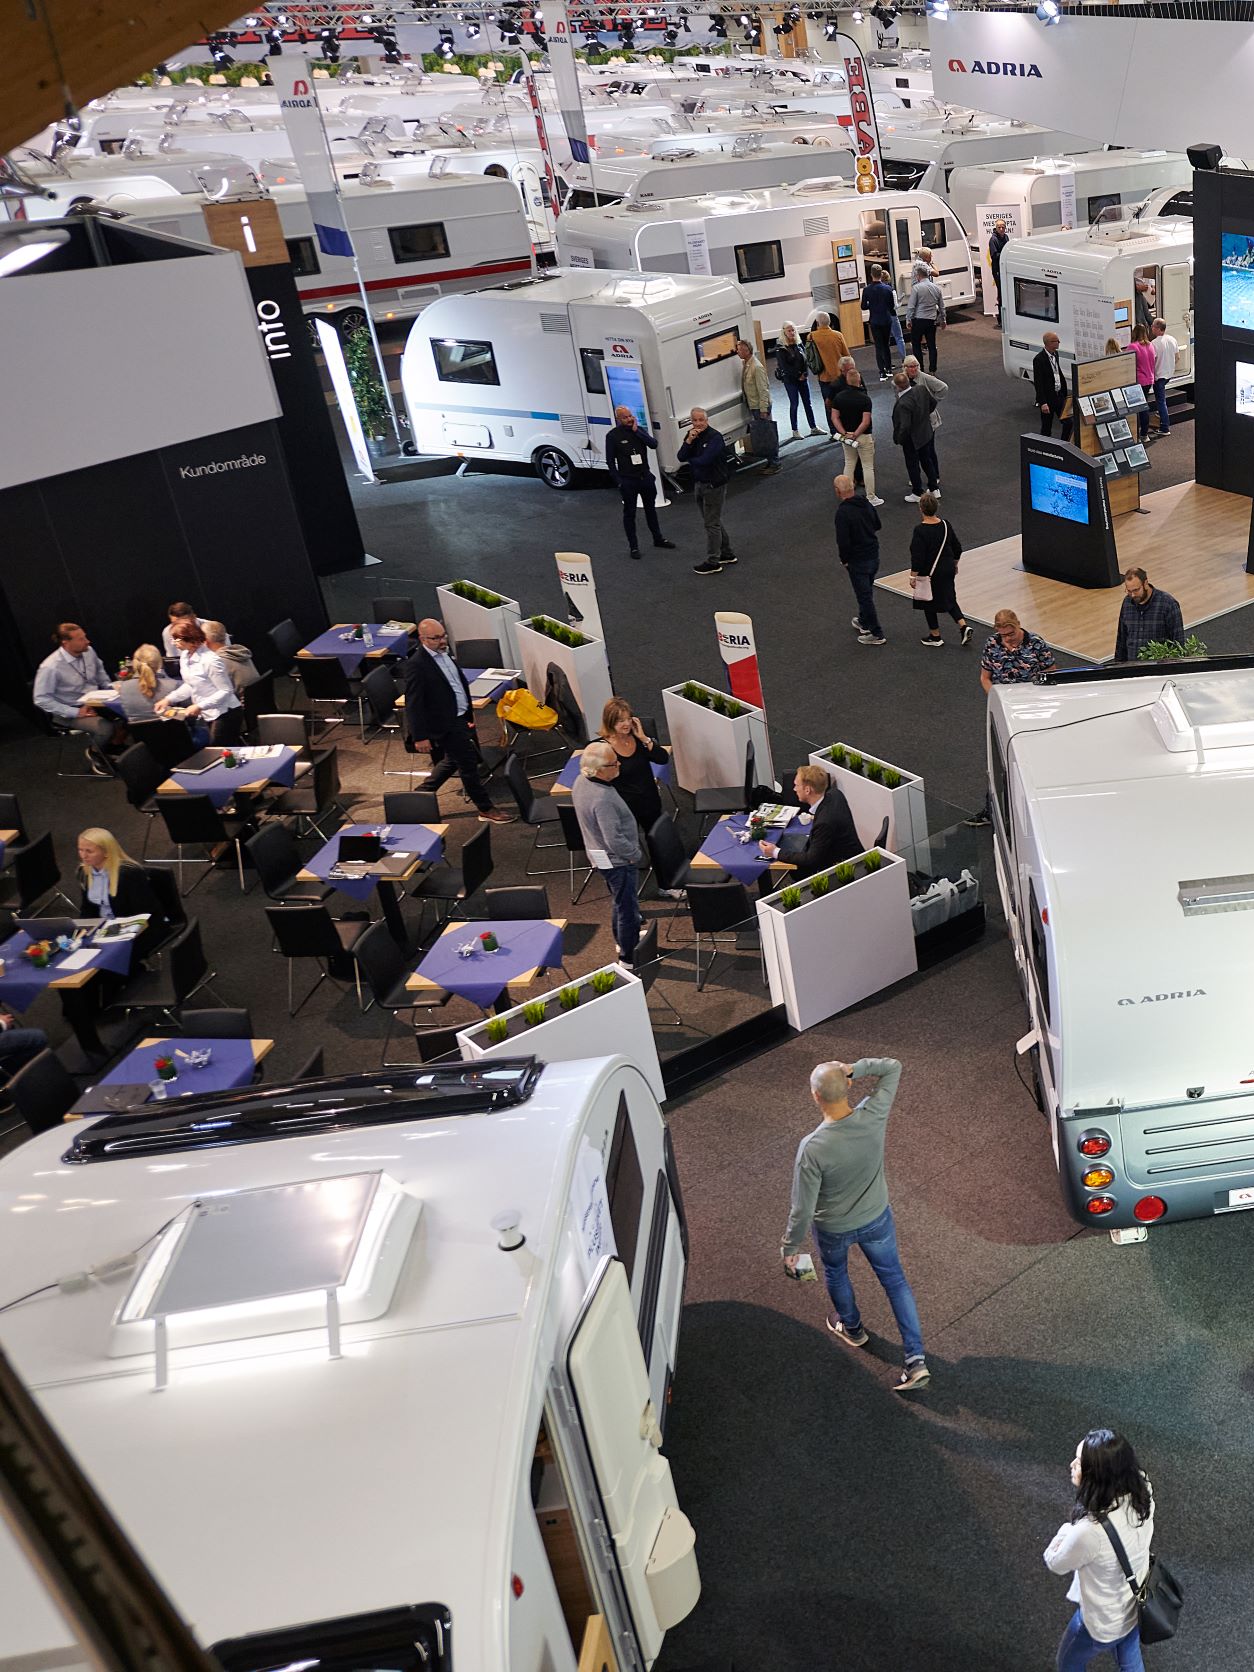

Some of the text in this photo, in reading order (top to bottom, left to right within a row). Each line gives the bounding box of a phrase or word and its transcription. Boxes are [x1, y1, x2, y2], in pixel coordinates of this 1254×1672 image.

[971, 60, 1043, 78] ADRIA
[179, 453, 266, 479] Kundområde
[1140, 988, 1207, 1004] ADRIA
